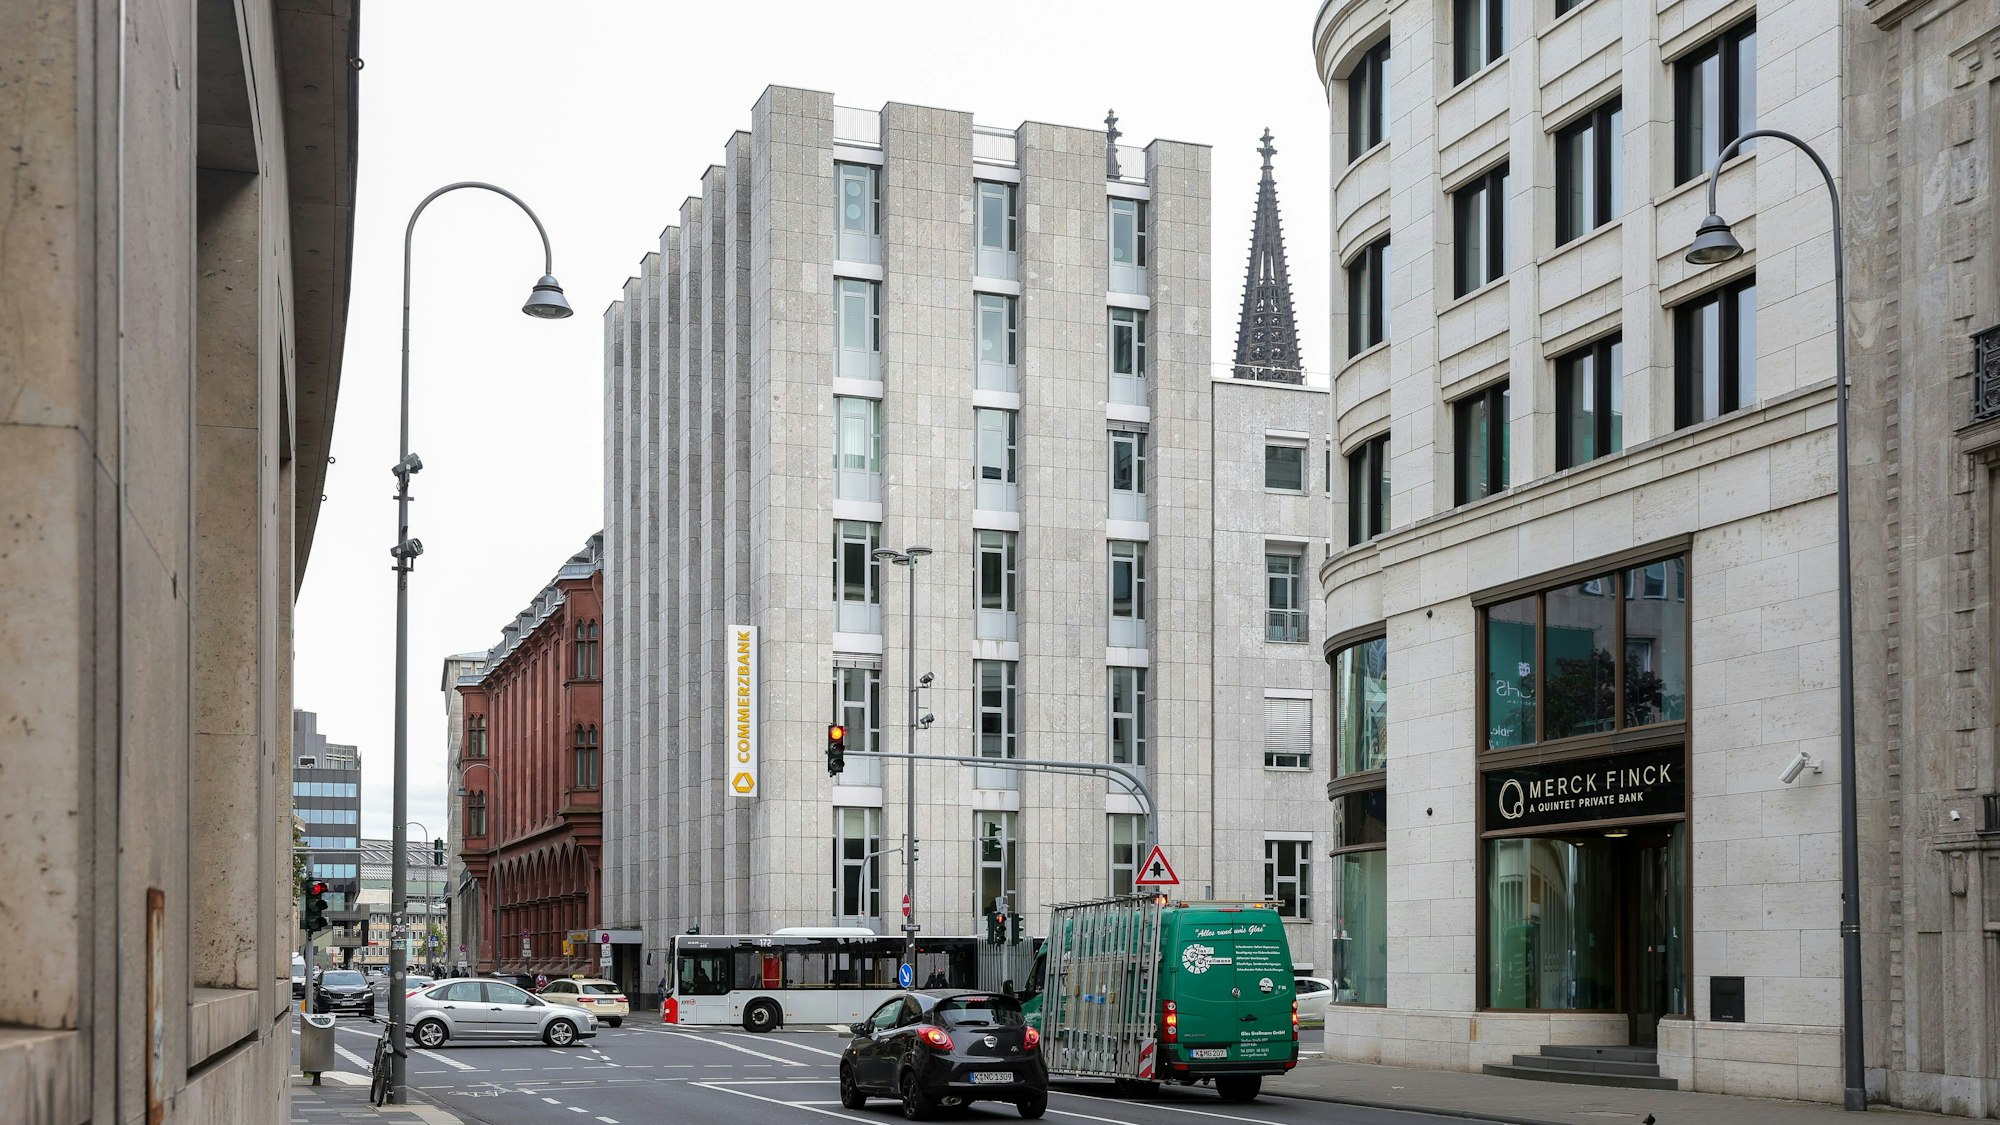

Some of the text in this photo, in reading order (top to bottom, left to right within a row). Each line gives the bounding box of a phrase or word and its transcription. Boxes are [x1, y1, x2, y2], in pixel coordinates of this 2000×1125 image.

[737, 630, 751, 764] COMMERZBANK
[1529, 763, 1672, 799] MERCK FINCK
[1529, 791, 1644, 813] A QUINTET PRIVATE BANK
[1216, 927, 1232, 936] rund
[759, 938, 772, 947] 172
[984, 1073, 994, 1081] NC
[994, 1073, 1012, 1081] 1309
